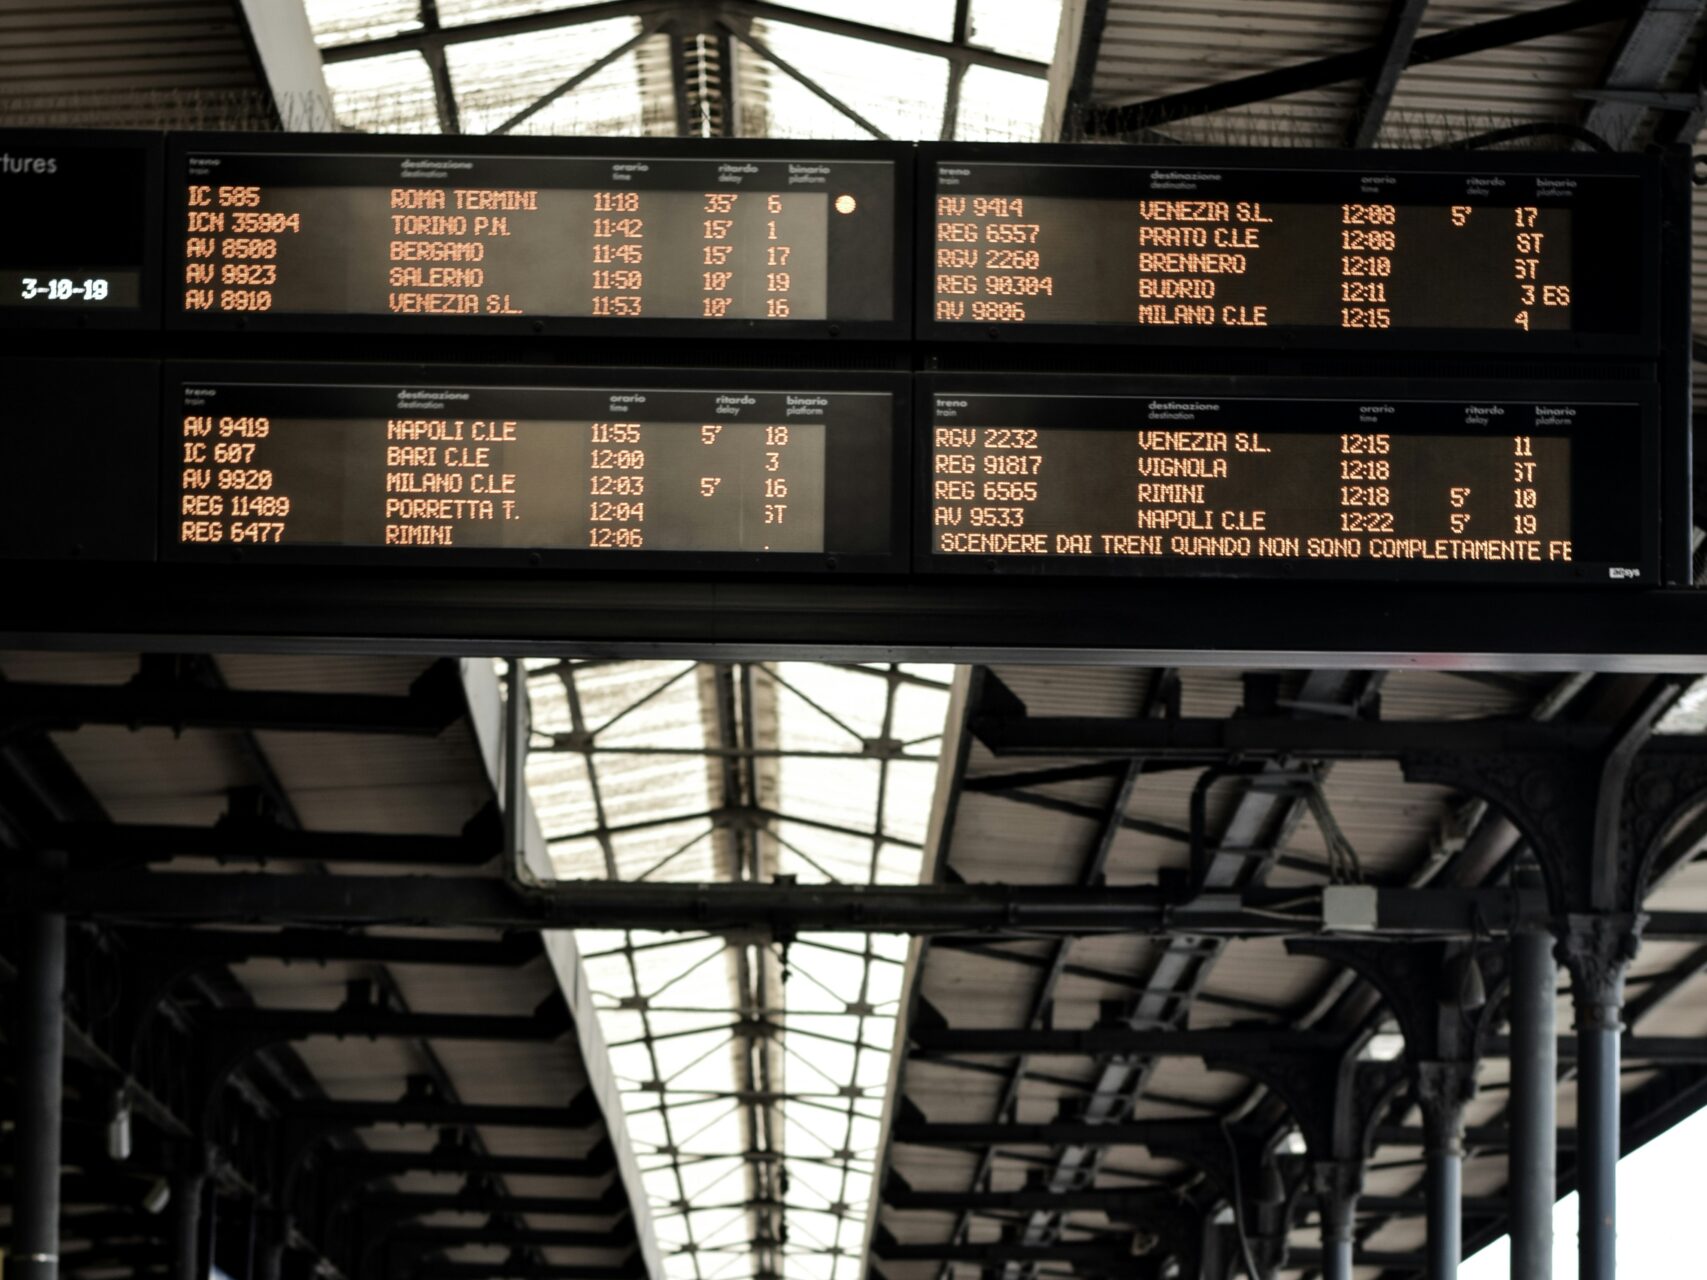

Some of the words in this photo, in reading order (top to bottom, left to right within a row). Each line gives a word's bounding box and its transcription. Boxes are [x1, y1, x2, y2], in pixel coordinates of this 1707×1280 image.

[0, 152, 58, 175] tures
[188, 185, 211, 206] IC
[390, 188, 446, 210] ROMA
[454, 189, 537, 211] TERMINI
[593, 191, 640, 212] 11:18
[703, 193, 737, 213] 35'
[767, 195, 783, 214] 6
[937, 196, 967, 217] AV
[972, 197, 1024, 218] 9414
[1139, 200, 1229, 222] VENEZIA
[1236, 202, 1271, 223] S.L.
[1451, 206, 1472, 226] 5'
[1516, 207, 1538, 227] 17
[188, 211, 225, 232] ICN
[392, 214, 468, 236] TORINO
[593, 217, 644, 238] 11:42
[703, 219, 733, 240] 15'
[767, 220, 778, 240] 1
[937, 222, 979, 243] REG
[985, 223, 1040, 244] 6557
[1139, 226, 1207, 247] PRATO
[1214, 227, 1259, 248] C.LE
[186, 237, 215, 258] AV
[389, 240, 485, 262] BERGAMO
[592, 243, 643, 264] 11:45
[703, 245, 733, 265] 15'
[767, 245, 791, 267] 17
[936, 248, 979, 269] RGV
[985, 249, 1040, 270] 2260
[1139, 252, 1246, 274] BRENNERO
[1342, 255, 1391, 277] 12:10
[186, 263, 215, 284] AV
[389, 266, 485, 288] SALERNO
[592, 269, 643, 290] 11:50
[703, 271, 733, 291] 10'
[767, 271, 790, 292] 19
[936, 274, 978, 295] REG
[984, 275, 1053, 296] 90304
[1138, 278, 1216, 299] BUDRIO
[1341, 281, 1386, 302] 12:11
[1521, 284, 1535, 305] 3
[1543, 285, 1570, 306] ES
[185, 289, 214, 310] AV
[389, 292, 479, 314] VENEZIA
[486, 293, 523, 315] S.L.
[592, 295, 642, 316] 11:53
[703, 297, 733, 317] 10'
[767, 297, 791, 317] 16
[936, 299, 965, 320] AV
[1138, 304, 1215, 325] MILANO
[1222, 305, 1266, 326] C.LE
[1342, 307, 1390, 328] 12:15
[1514, 310, 1529, 330] 4
[183, 416, 212, 437] AV
[219, 416, 270, 438] 9419
[387, 420, 464, 441] NAPOLI
[471, 421, 517, 442] C.LE
[591, 423, 641, 444] 11:55
[700, 425, 722, 445] 5'
[766, 427, 789, 447] 18
[935, 428, 977, 448] RGV
[984, 429, 1038, 449] 2232
[1138, 431, 1227, 452] VENEZIA
[1235, 432, 1270, 453] S.L.
[1341, 434, 1390, 454] 12:15
[1514, 436, 1532, 457] 11
[183, 442, 207, 463] IC
[214, 442, 256, 464] 607
[386, 445, 437, 467] BARI
[444, 446, 488, 468] C.LE
[591, 448, 645, 470] 12:00
[765, 452, 779, 472] 3
[934, 453, 976, 474] REG
[983, 455, 1042, 475] 91817
[1138, 457, 1228, 478] VIGNOLA
[1340, 460, 1390, 480] 12:18
[182, 468, 211, 489] AV
[218, 469, 273, 490] 9920
[386, 472, 464, 494] MILANO
[470, 473, 517, 494] C.LE
[590, 475, 645, 496] 12:03
[700, 477, 721, 497] 5'
[765, 477, 788, 498] 16
[935, 479, 976, 501] REG
[983, 481, 1038, 501] 6565
[1137, 483, 1204, 504] RIMINI
[1341, 486, 1390, 507] 12:18
[1450, 487, 1471, 508] 5'
[1514, 488, 1537, 509] 10
[182, 494, 224, 516] REG
[385, 498, 494, 520] PORRETTA
[502, 499, 522, 521] T.
[590, 501, 644, 522] 12:04
[934, 506, 962, 526] AV
[970, 507, 1025, 527] 9533
[1137, 509, 1213, 530] NAPOLI
[1221, 510, 1265, 531] C.LE
[1341, 512, 1394, 533] 12:22
[1450, 513, 1471, 534] 5'
[1515, 514, 1537, 535] 19
[181, 521, 223, 542] REG
[230, 522, 285, 543] 6477
[385, 524, 453, 545] RIMINI
[590, 527, 643, 548] 12:06
[940, 532, 1046, 553] SCENDERE
[1056, 534, 1092, 554] DAI
[1101, 534, 1162, 555] TRENI
[1171, 536, 1251, 557] QUANDO
[1258, 537, 1299, 557] NON
[1307, 537, 1361, 558] SONO
[1369, 538, 1541, 561] COMPLETAMENTE
